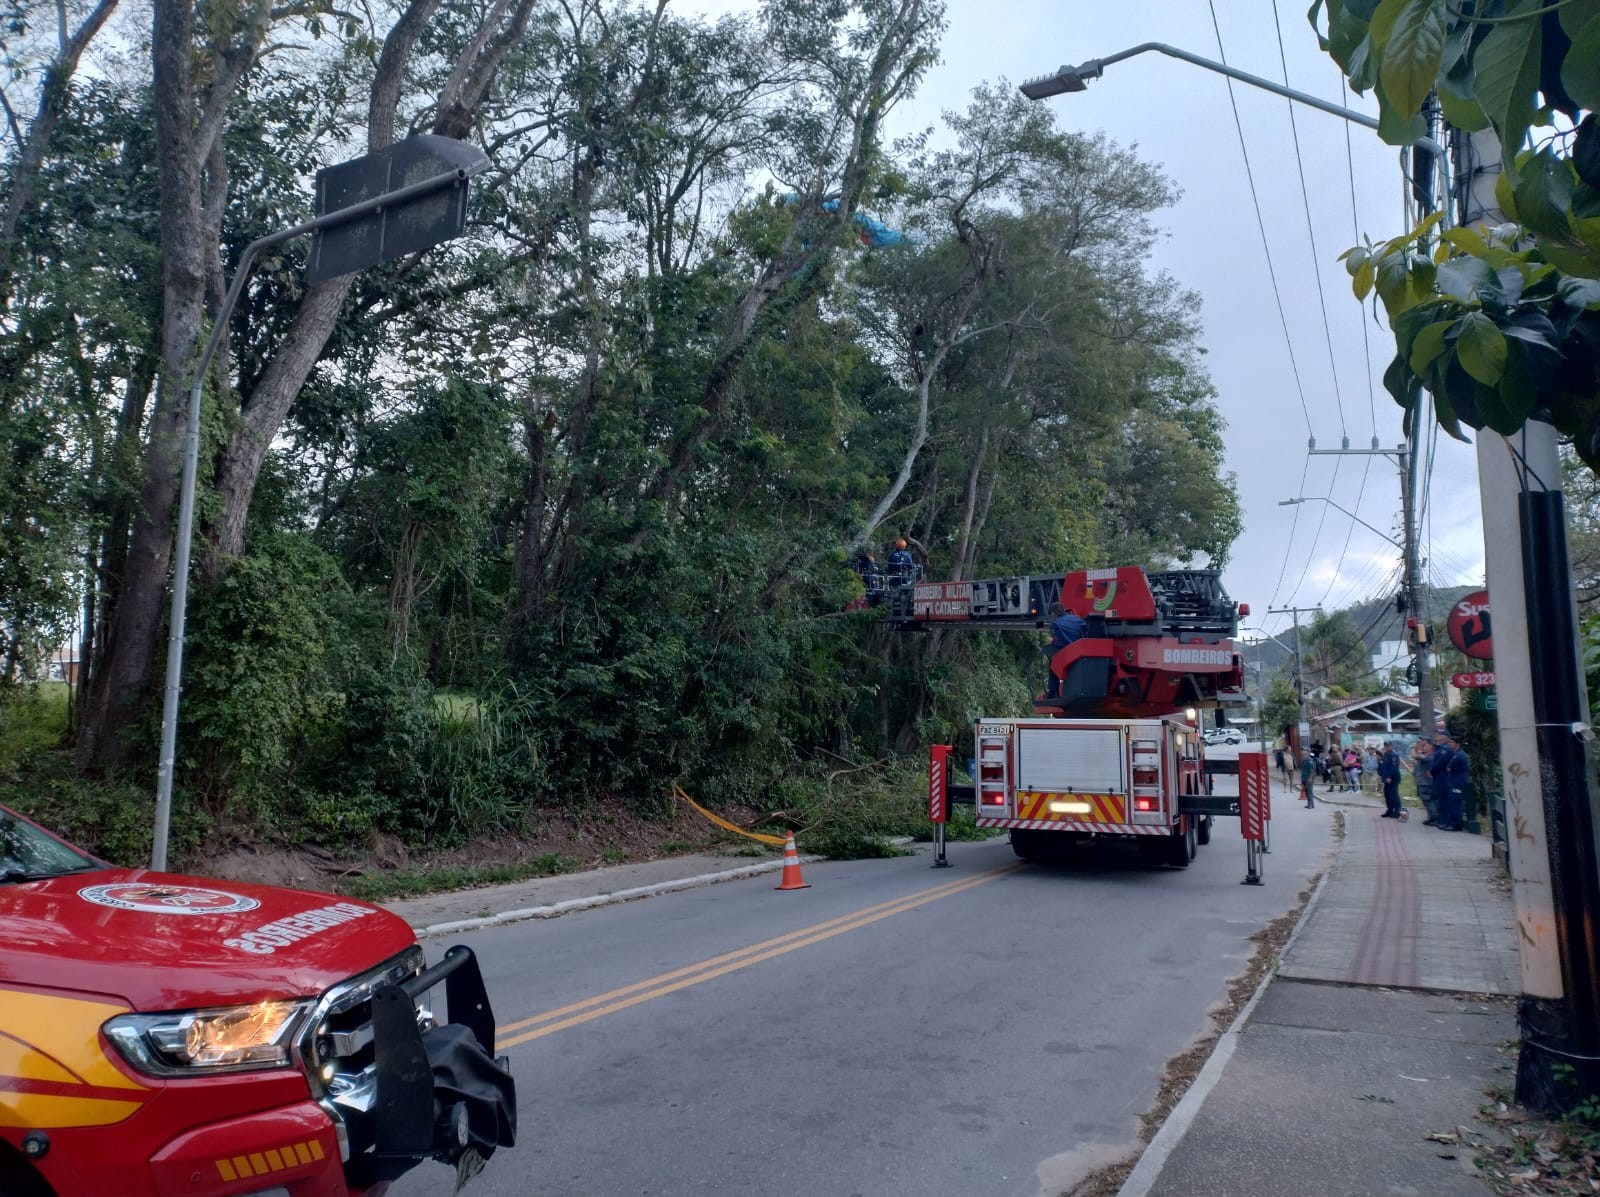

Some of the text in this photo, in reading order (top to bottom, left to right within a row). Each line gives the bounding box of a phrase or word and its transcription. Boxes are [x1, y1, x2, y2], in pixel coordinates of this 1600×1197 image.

[914, 600, 969, 616] SANTA CATARINA
[1163, 647, 1232, 665] BOMBEIROS
